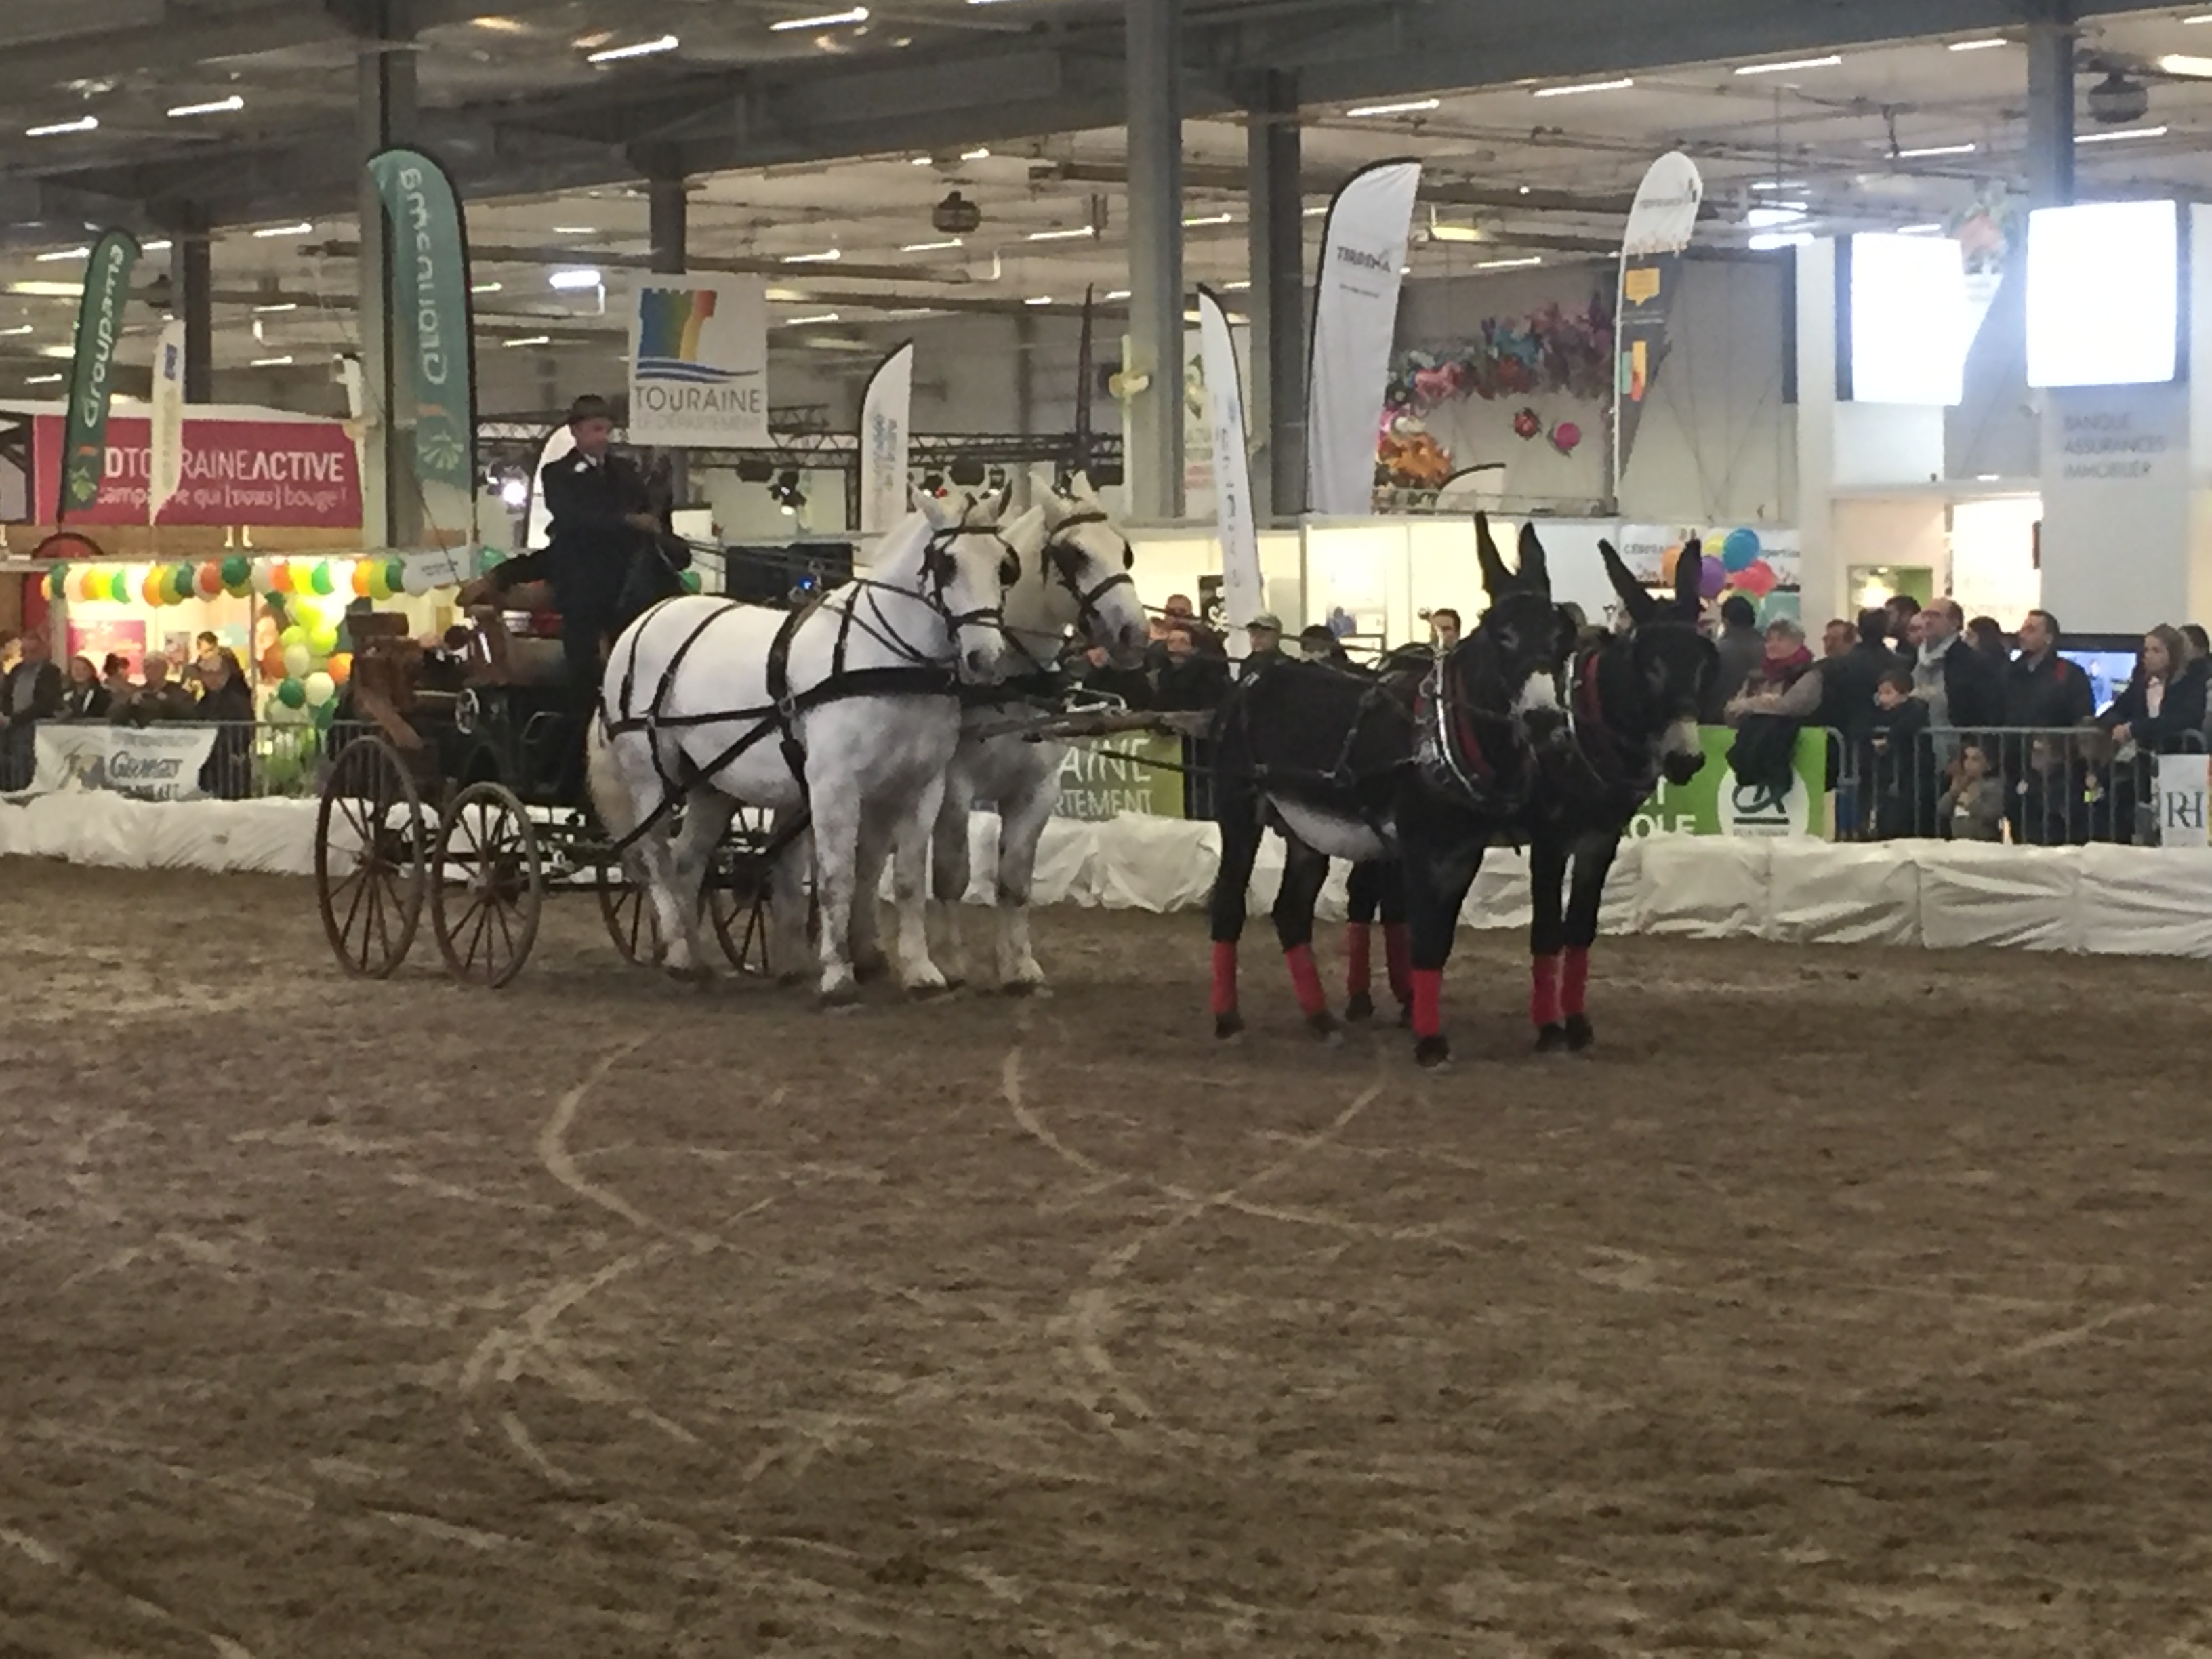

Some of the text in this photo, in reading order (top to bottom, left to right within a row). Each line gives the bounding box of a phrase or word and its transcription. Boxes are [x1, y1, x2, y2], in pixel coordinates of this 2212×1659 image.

[83, 244, 125, 428] Groupama
[635, 386, 761, 414] TOURAINE
[1055, 737, 1151, 783] AINE
[1052, 789, 1152, 817] RTEMENT
